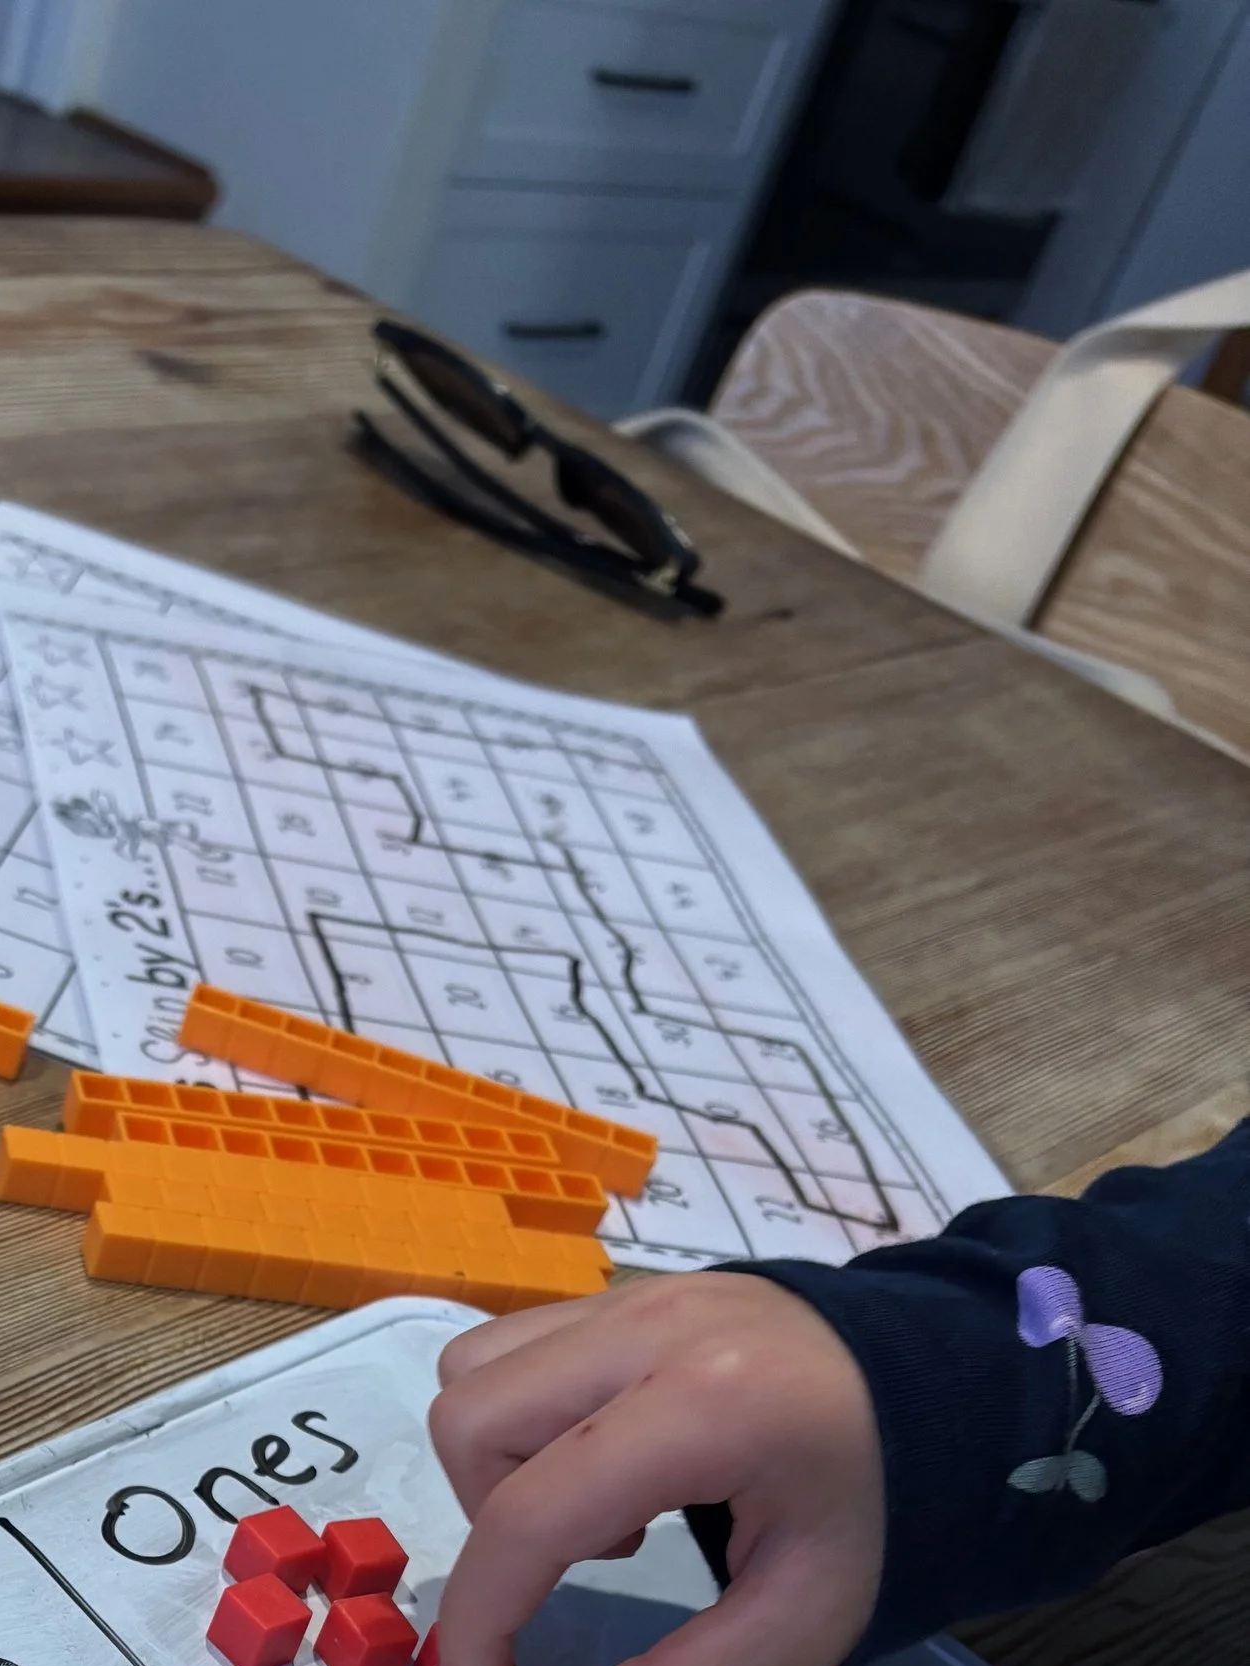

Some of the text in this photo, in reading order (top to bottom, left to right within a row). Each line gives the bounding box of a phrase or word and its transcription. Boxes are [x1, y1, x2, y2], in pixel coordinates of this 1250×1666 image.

[124, 942, 200, 989] by
[224, 947, 264, 971] 10
[443, 983, 489, 1010] 20
[595, 1085, 639, 1110] 18
[644, 1178, 691, 1210] 20
[753, 1195, 804, 1225] 22
[100, 1409, 359, 1566] Ones
